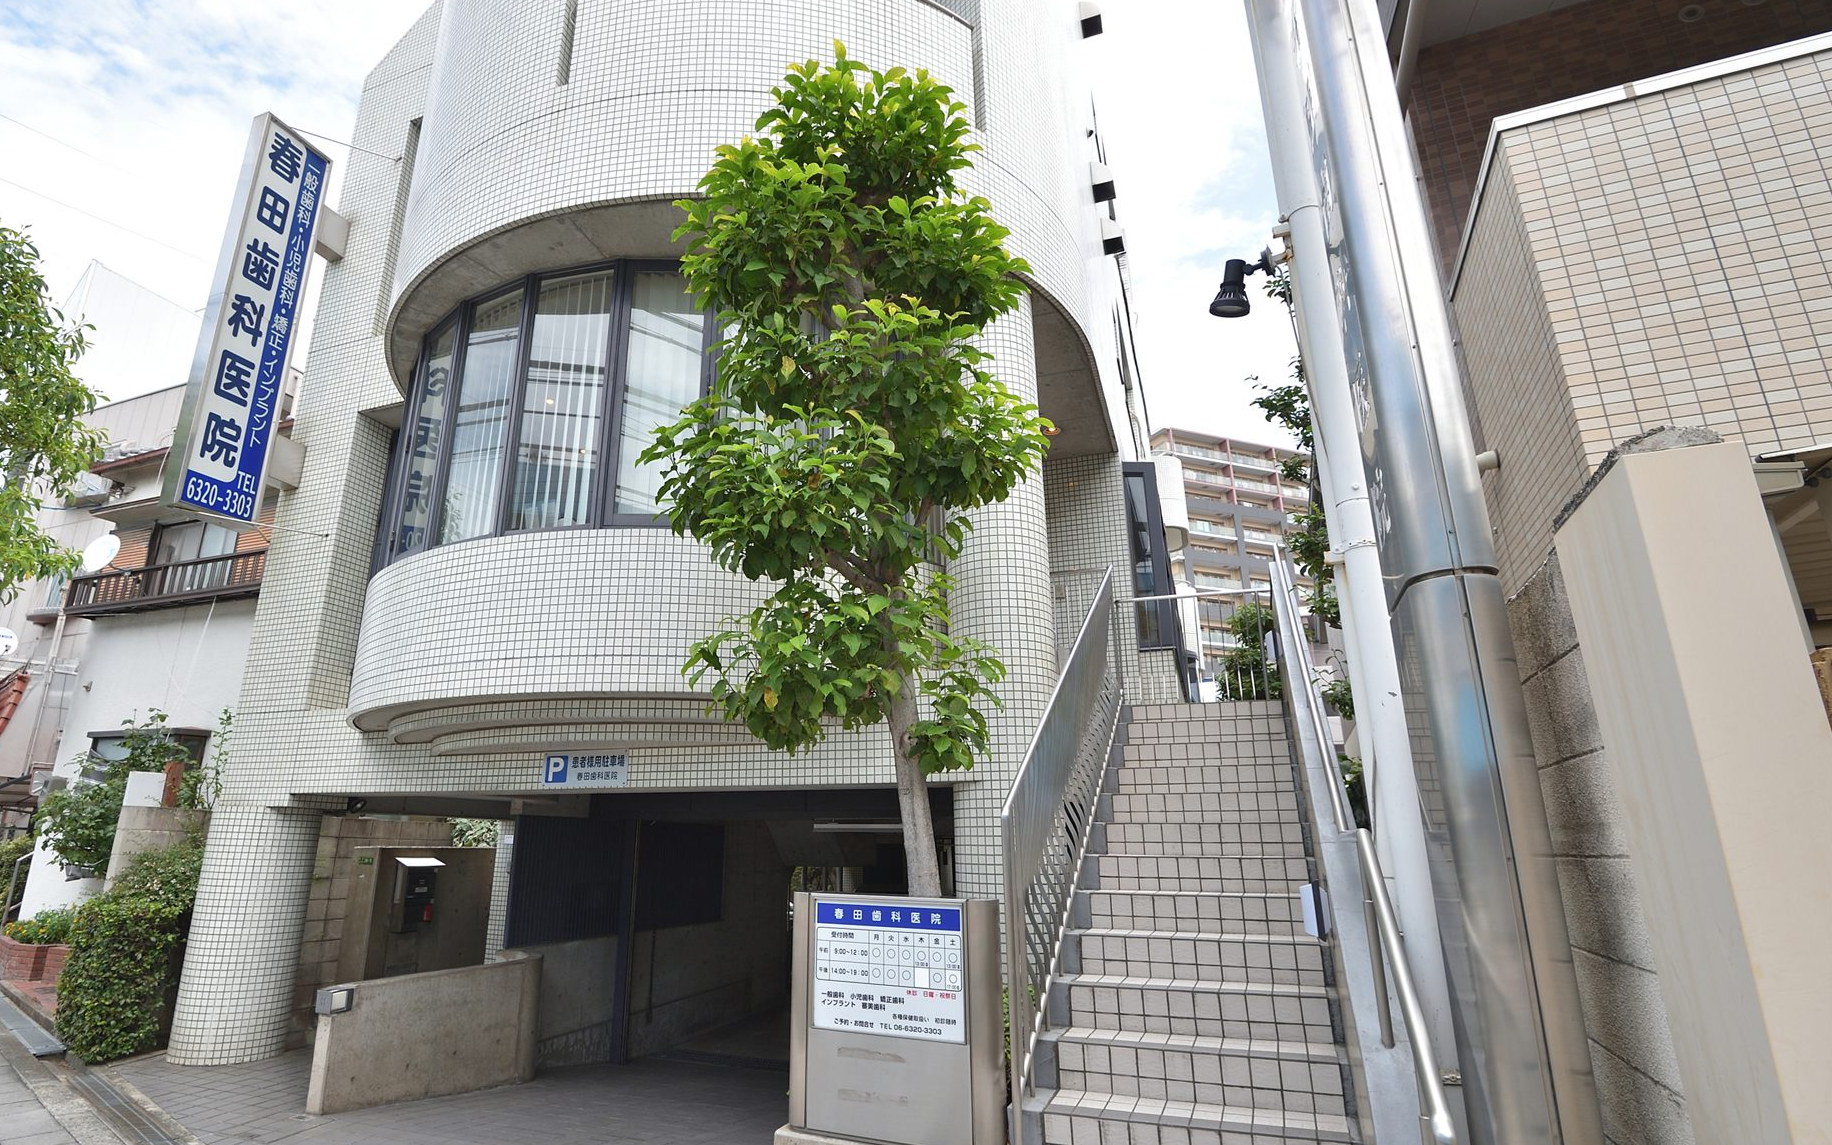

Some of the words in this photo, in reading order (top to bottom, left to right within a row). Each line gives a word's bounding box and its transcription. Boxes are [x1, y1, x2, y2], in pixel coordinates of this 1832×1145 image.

[199, 132, 303, 468] 春田歯科医院
[237, 471, 256, 495] TEL
[187, 477, 252, 518] 6320-3303
[571, 755, 625, 768] 患者様用駐車場
[547, 757, 565, 782] P
[577, 771, 618, 781] 春田歯科医院
[834, 908, 942, 925] 春田歯科医院
[831, 931, 854, 939] 受付時間
[873, 933, 880, 941] 月
[821, 991, 844, 999] 一般歯科
[850, 993, 874, 1002] 小児歯科
[821, 998, 856, 1008] インプラント
[862, 1002, 886, 1011] 審美歯科
[880, 1022, 892, 1030] TEL
